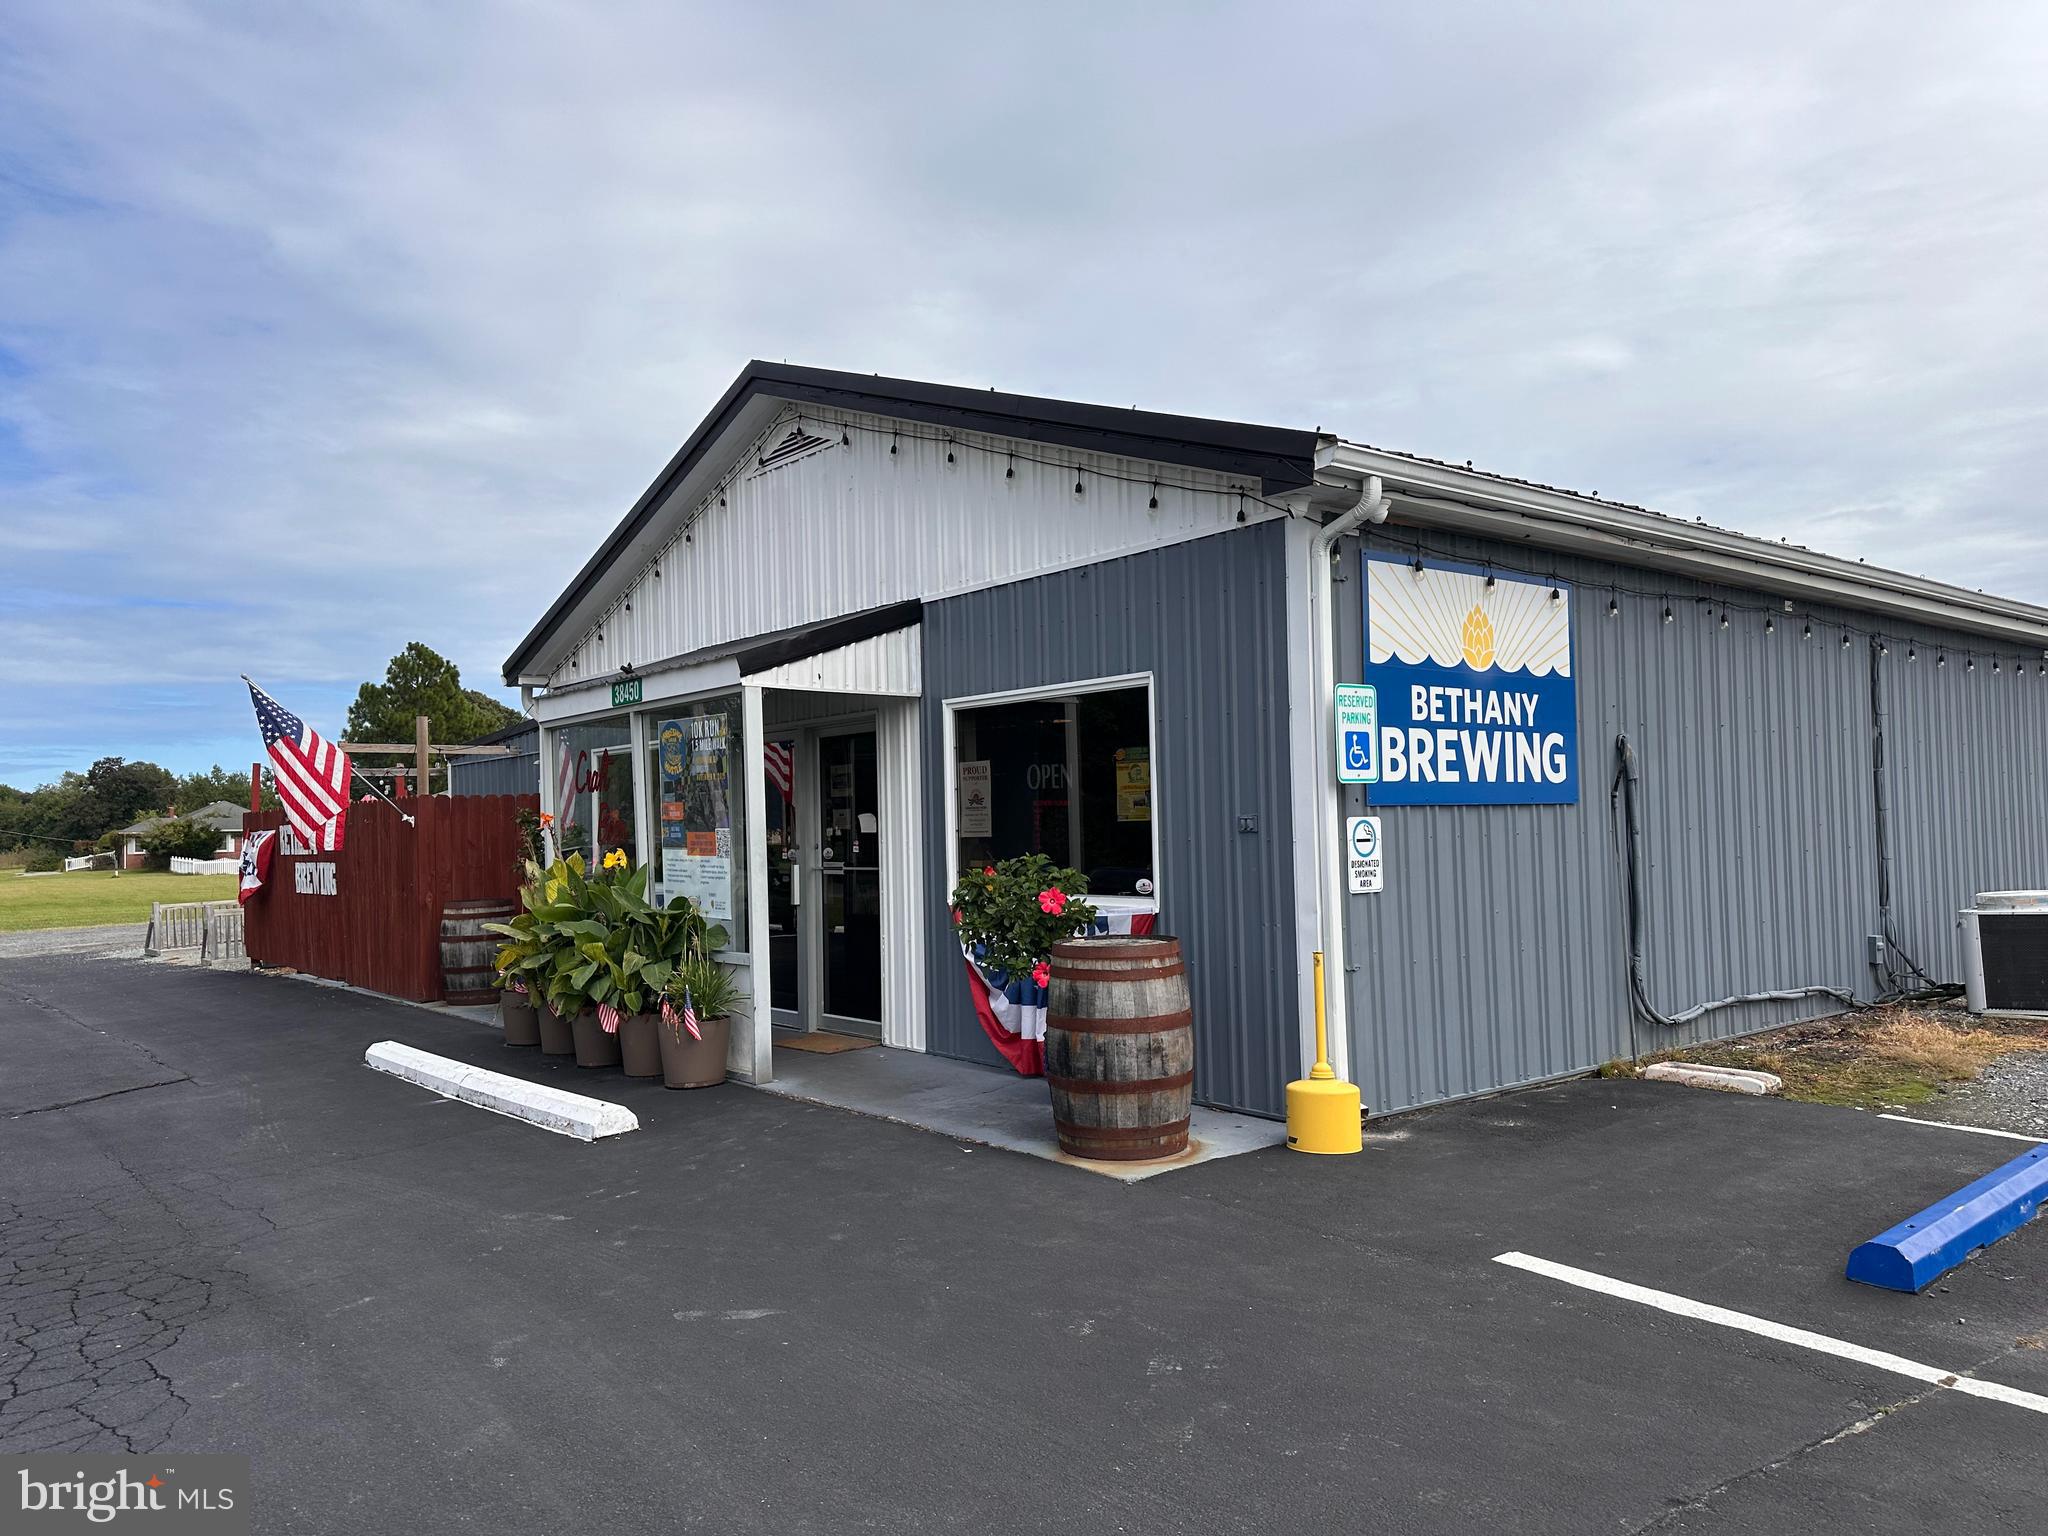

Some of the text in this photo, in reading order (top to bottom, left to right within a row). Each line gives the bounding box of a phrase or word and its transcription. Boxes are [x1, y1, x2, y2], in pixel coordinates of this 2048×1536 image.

[614, 680, 640, 704] 38450
[1338, 694, 1373, 708] RESERVED
[1411, 684, 1539, 727] BETHANY
[1341, 712, 1371, 725] PARKING
[690, 720, 704, 739] 10K
[704, 719, 720, 738] RUN
[1381, 726, 1567, 784] BREWING
[962, 765, 988, 775] PROUD
[1026, 763, 1073, 790] OPEN
[1351, 859, 1380, 868] DESIGNATED
[294, 861, 338, 896] BREWING
[1354, 869, 1377, 878] SMOKING
[1359, 879, 1373, 888] AREA
